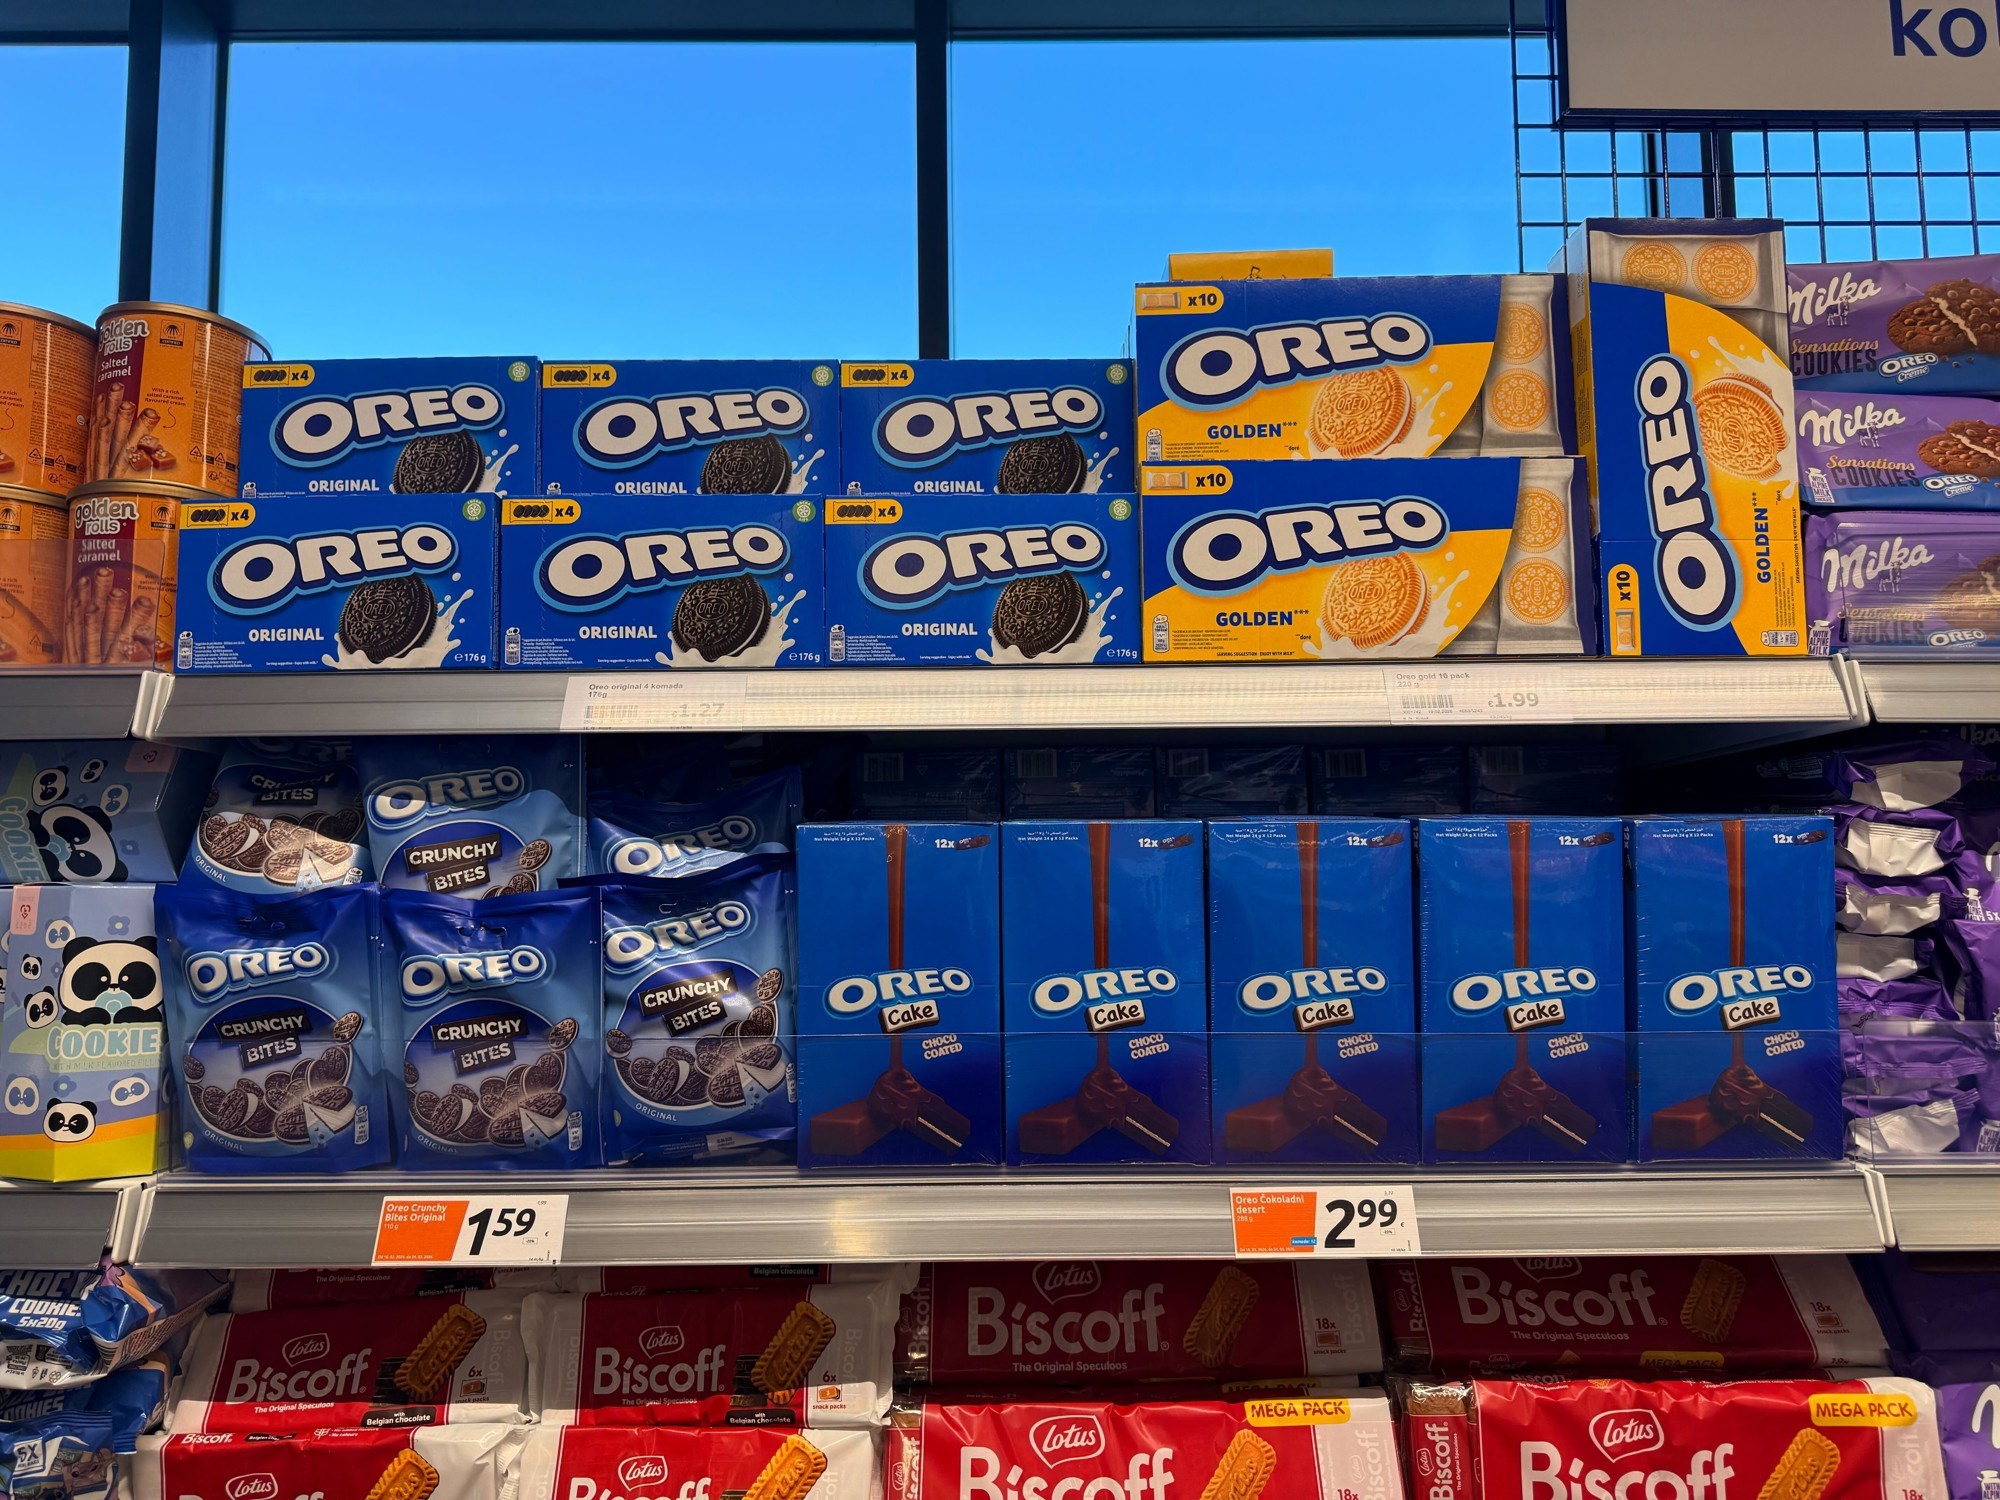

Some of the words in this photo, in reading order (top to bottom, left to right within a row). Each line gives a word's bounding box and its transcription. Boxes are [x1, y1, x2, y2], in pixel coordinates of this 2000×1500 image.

[1187, 293, 1217, 307] x10
[1788, 272, 1882, 326] Milka
[99, 318, 149, 352] golden
[104, 337, 132, 356] rolls
[1792, 338, 1879, 355] Sensations
[101, 356, 127, 371] Salted
[1175, 317, 1426, 395] OREO
[1790, 351, 1877, 376] COOKIES
[1881, 354, 1936, 374] OREO
[97, 367, 131, 383] caramel
[291, 369, 309, 381] x4
[592, 370, 611, 381] x4
[891, 370, 908, 381] x4
[283, 387, 498, 453] OREO
[586, 390, 803, 455] OREO
[886, 390, 1098, 453] OREO
[1799, 402, 1905, 446] Milka
[1826, 455, 1915, 470] Sensations
[309, 480, 379, 492] ORIGINAL
[1196, 474, 1226, 487] x10
[1832, 467, 1920, 487] COOKIES
[1925, 475, 1978, 489] OREO
[615, 482, 687, 493] ORIGINAL
[914, 481, 984, 493] ORIGINAL
[1638, 360, 1727, 616] OREO
[75, 497, 139, 528] golden
[231, 509, 249, 521] x4
[555, 506, 574, 517] x4
[878, 506, 896, 517] x4
[85, 518, 121, 535] rolls
[82, 539, 115, 551] Salted
[1182, 501, 1442, 581] OREO
[78, 550, 121, 563] caramel
[222, 527, 451, 599] OREO
[548, 527, 783, 596] OREO
[872, 526, 1100, 595] OREO
[1821, 537, 1934, 592] Milka
[1616, 571, 1630, 601] x10
[249, 628, 324, 642] ORIGINAL
[579, 626, 657, 639] ORIGINAL
[902, 623, 977, 636] ORIGINAL
[1929, 630, 1985, 646] OREO
[1809, 637, 1829, 645] ALPINE
[464, 653, 477, 662] 176
[480, 655, 486, 663] g
[799, 653, 812, 661] 176
[814, 654, 820, 662] g
[1116, 649, 1129, 657] 176
[1132, 651, 1137, 659] g
[1808, 646, 1828, 655] MILK
[612, 683, 641, 691] original
[1494, 693, 1539, 707] 1.99
[371, 769, 521, 819] OREO
[935, 839, 954, 849] 12x
[1773, 834, 1793, 844] 12x
[409, 841, 497, 865] CRUNCHY
[434, 866, 486, 890] BITES
[606, 904, 746, 963] OREO
[189, 946, 322, 992] OREO
[402, 950, 540, 995] OREO
[644, 977, 731, 1008] CRUNCHY
[829, 969, 971, 1012] OREO
[1034, 969, 1175, 1012] OREO
[1242, 968, 1386, 1010] OREO
[1453, 968, 1596, 1010] OREO
[1669, 967, 1811, 1010] OREO
[671, 1001, 721, 1031] BITES
[888, 1002, 934, 1027] Cake
[1094, 1004, 1140, 1027] Cake
[1302, 1002, 1349, 1024] Cake
[1513, 1002, 1560, 1024] Cake
[1729, 1000, 1775, 1023] Cake
[220, 1015, 305, 1038] CRUNCHY
[437, 1018, 521, 1041] CRUNCHY
[922, 1034, 957, 1050] CHOCO
[1129, 1034, 1164, 1050] CHOCO
[1338, 1033, 1373, 1048] CHOCO
[1548, 1033, 1584, 1048] CHOCO
[1764, 1031, 1799, 1046] CHOCO
[1766, 1039, 1805, 1056] COATED
[246, 1037, 298, 1062] BITES
[461, 1043, 511, 1068] BITES
[924, 1042, 963, 1060] COATED
[1131, 1042, 1169, 1060] COATED
[1339, 1042, 1378, 1059] COATED
[1550, 1042, 1588, 1059] COATED
[1235, 1195, 1257, 1204] Oreo
[1260, 1194, 1304, 1204] Čokoladni
[385, 1213, 407, 1221] Bites
[410, 1213, 446, 1222] Original
[387, 1204, 409, 1212] Oreo
[411, 1204, 447, 1214] Crunchy
[1237, 1205, 1265, 1213] desert
[968, 1282, 1165, 1356] Biscoff
[226, 1348, 371, 1404] Biscoff
[594, 1344, 725, 1394] Biscoff
[269, 1404, 297, 1413] Original
[299, 1401, 334, 1411] Speculoos
[1250, 1400, 1299, 1418] MEGA
[1302, 1399, 1345, 1417] PACK
[1816, 1401, 1864, 1419] MEGA
[1868, 1401, 1912, 1418] PACK
[367, 1416, 396, 1427] Belgian
[399, 1413, 431, 1425] chocolate
[1042, 1426, 1097, 1453] Lotus
[1602, 1420, 1655, 1446] Lotus
[16, 1444, 38, 1462] 5X
[624, 1461, 664, 1482] Lotus
